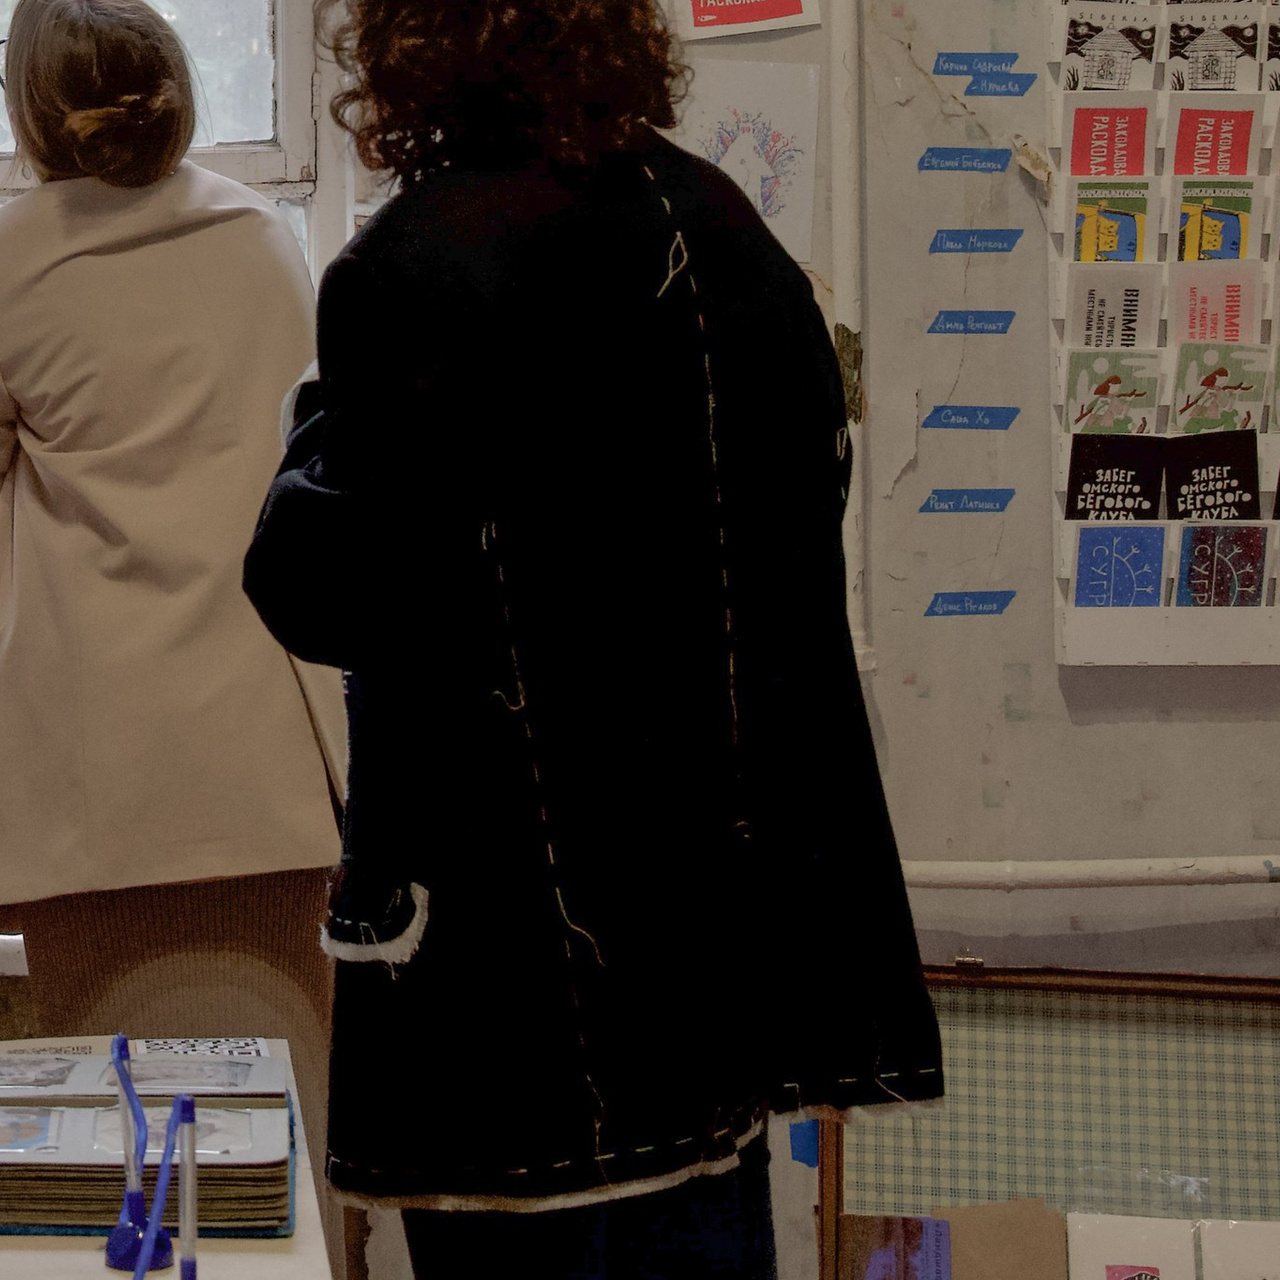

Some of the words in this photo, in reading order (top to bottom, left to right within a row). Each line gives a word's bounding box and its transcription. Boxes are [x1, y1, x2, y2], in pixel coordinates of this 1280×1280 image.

[1078, 12, 1150, 24] SIBERIA
[1179, 13, 1250, 23] SIBERIA
[1224, 285, 1241, 342] ВНИМА
[1095, 467, 1136, 483] ЗАБЕГ
[1191, 465, 1231, 482] ЗАБЕГ
[1082, 483, 1141, 494] ОМСКОГО
[1180, 478, 1239, 495] ОМСКОГО
[1077, 494, 1152, 510] БЕГОВОГО
[1177, 492, 1252, 512] БЕГОВОГО
[1088, 510, 1136, 520] КЛУБА
[1190, 506, 1239, 520] КЛУБА
[1089, 544, 1110, 606] СУГР
[1190, 544, 1211, 605] СУГР
